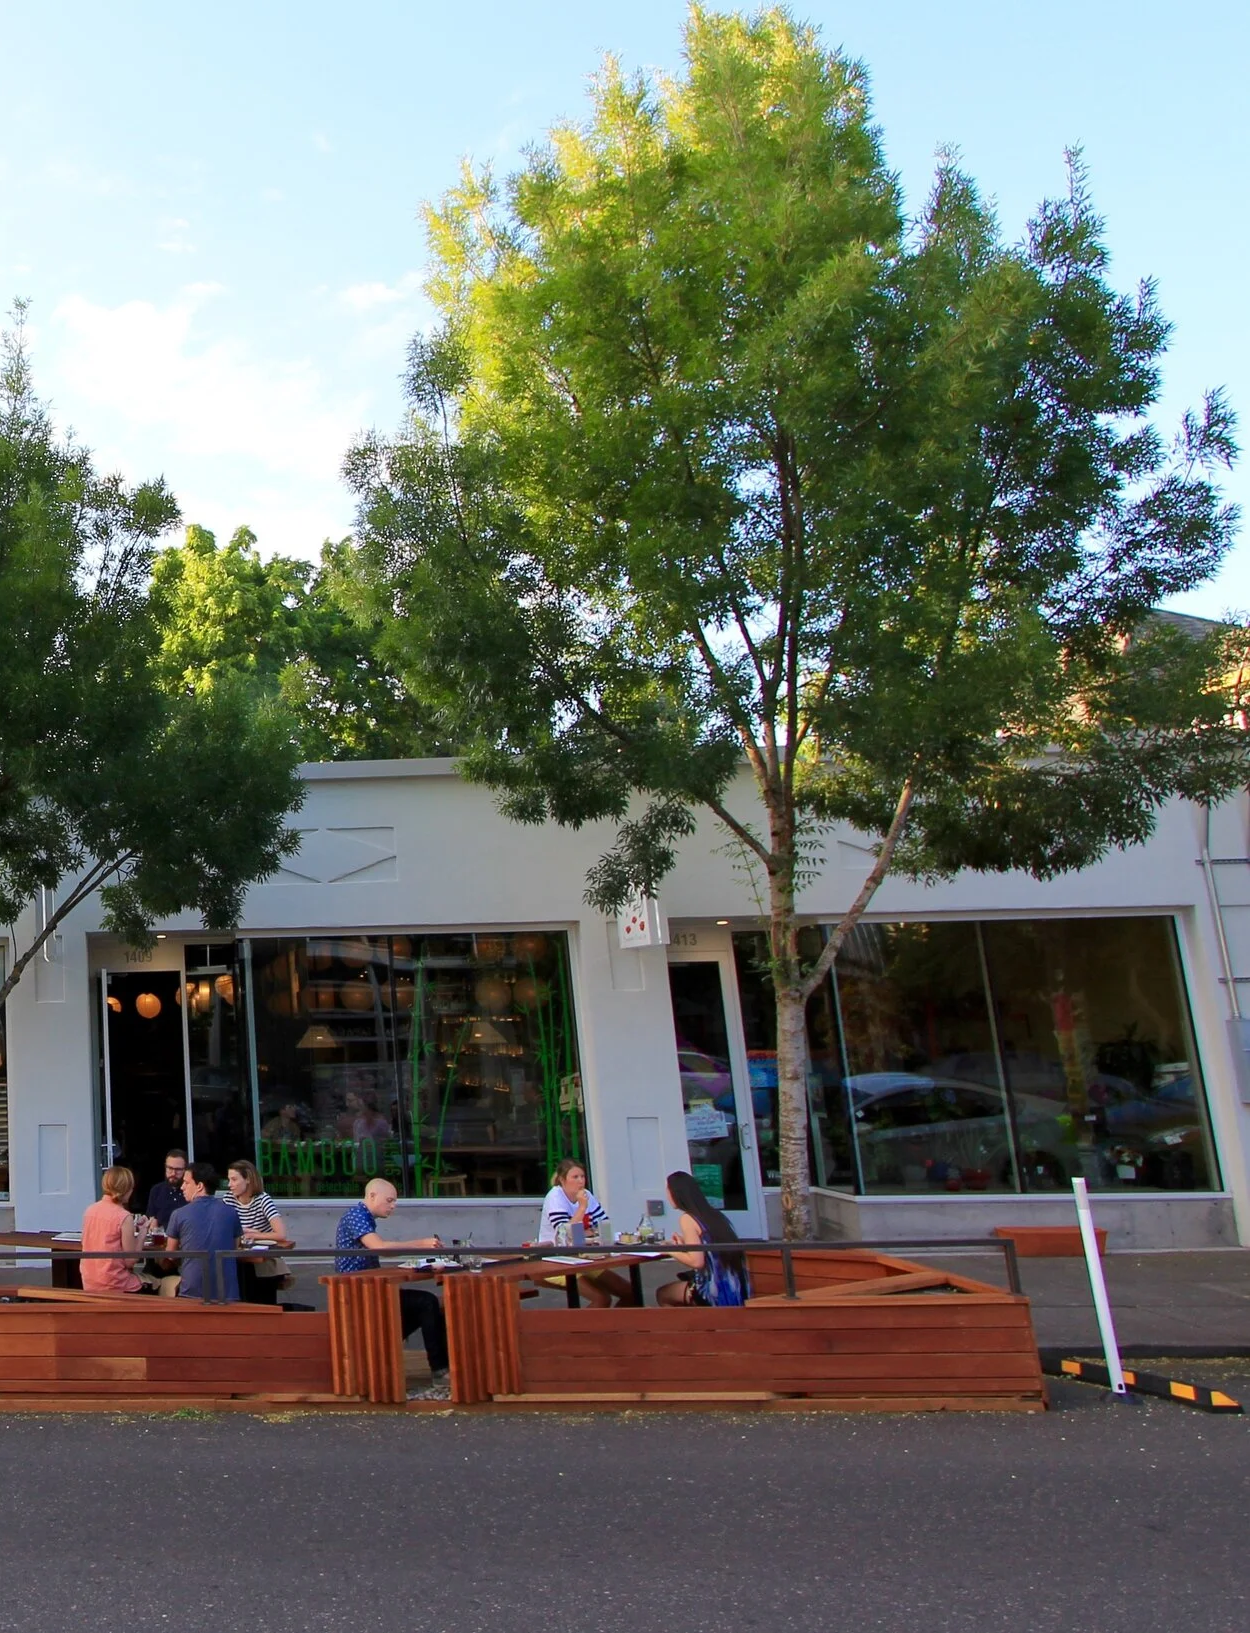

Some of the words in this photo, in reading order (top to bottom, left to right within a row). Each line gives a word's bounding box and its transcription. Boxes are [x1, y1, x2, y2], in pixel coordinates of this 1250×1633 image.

[672, 933, 698, 946] 413
[123, 950, 153, 964] 1409
[259, 1138, 378, 1176] BAMBOO
